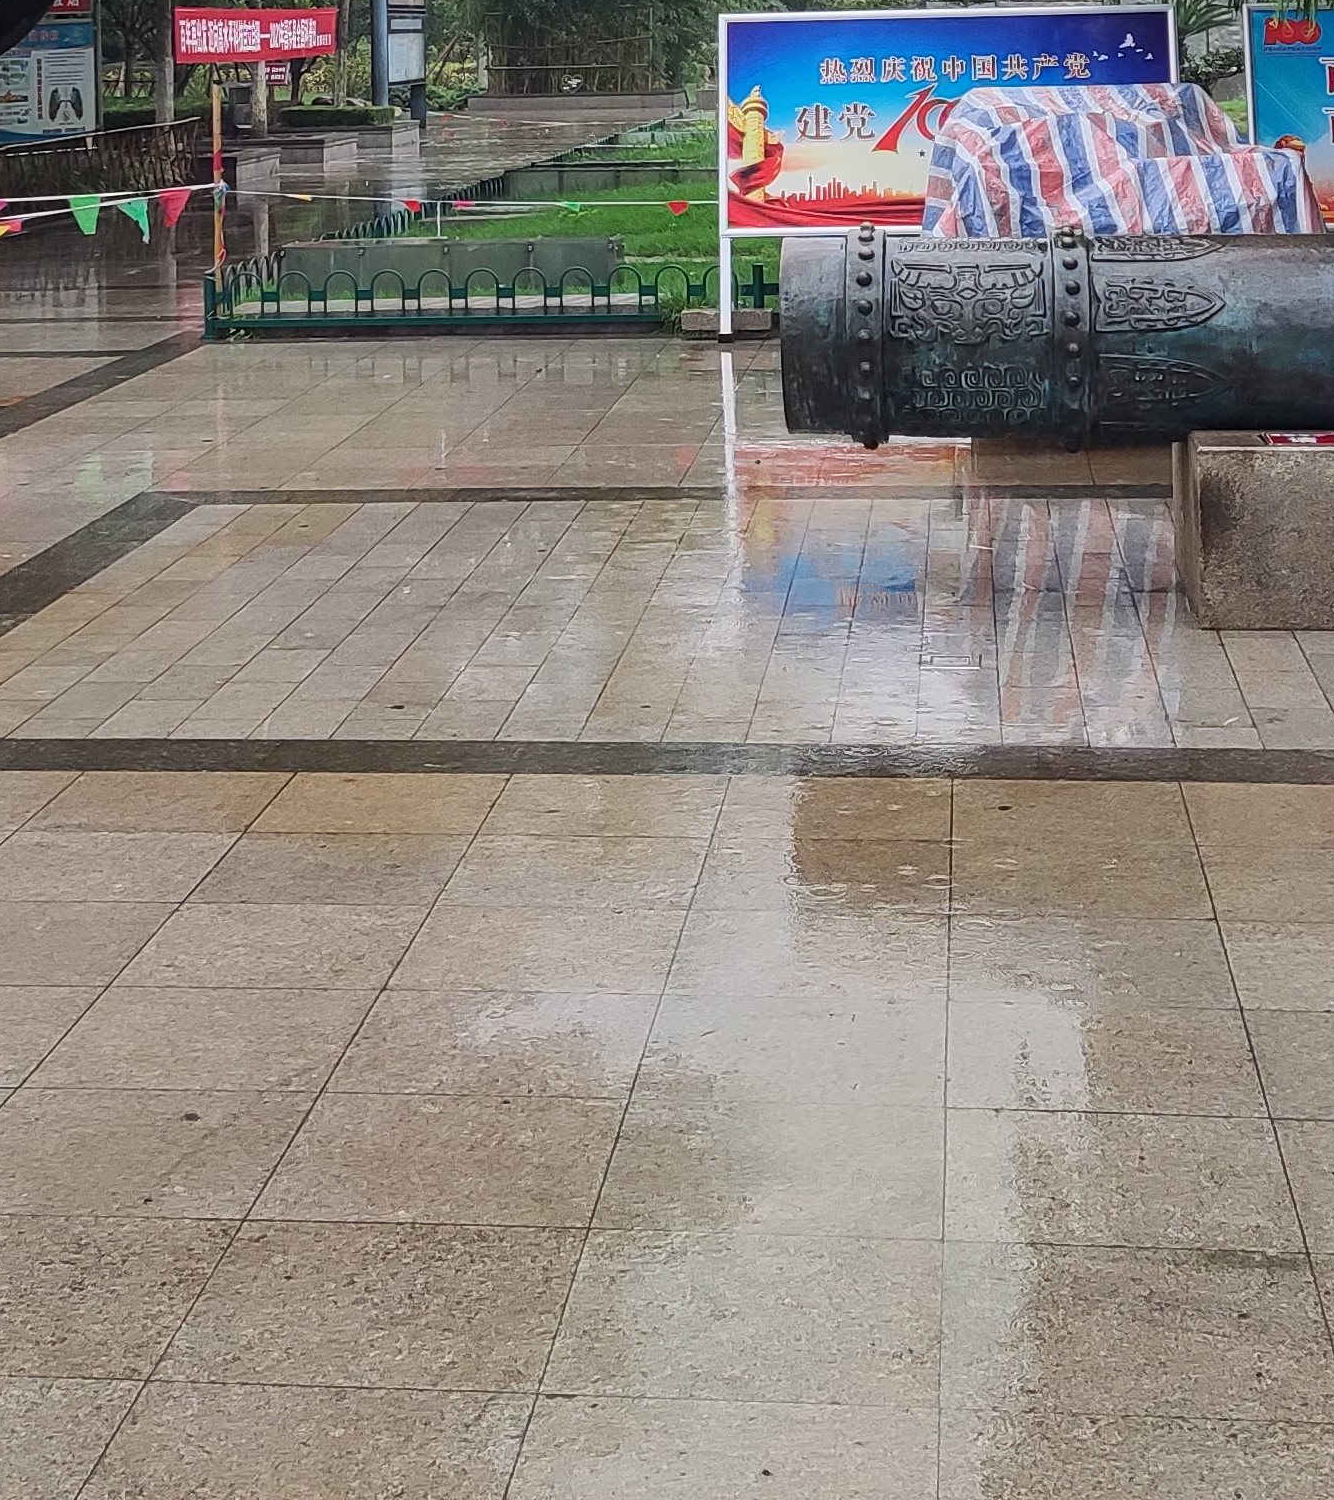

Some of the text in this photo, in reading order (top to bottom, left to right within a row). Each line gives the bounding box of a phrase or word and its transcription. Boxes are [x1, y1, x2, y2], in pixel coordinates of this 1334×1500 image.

[819, 53, 1092, 84] 热烈庆祝中国共产党
